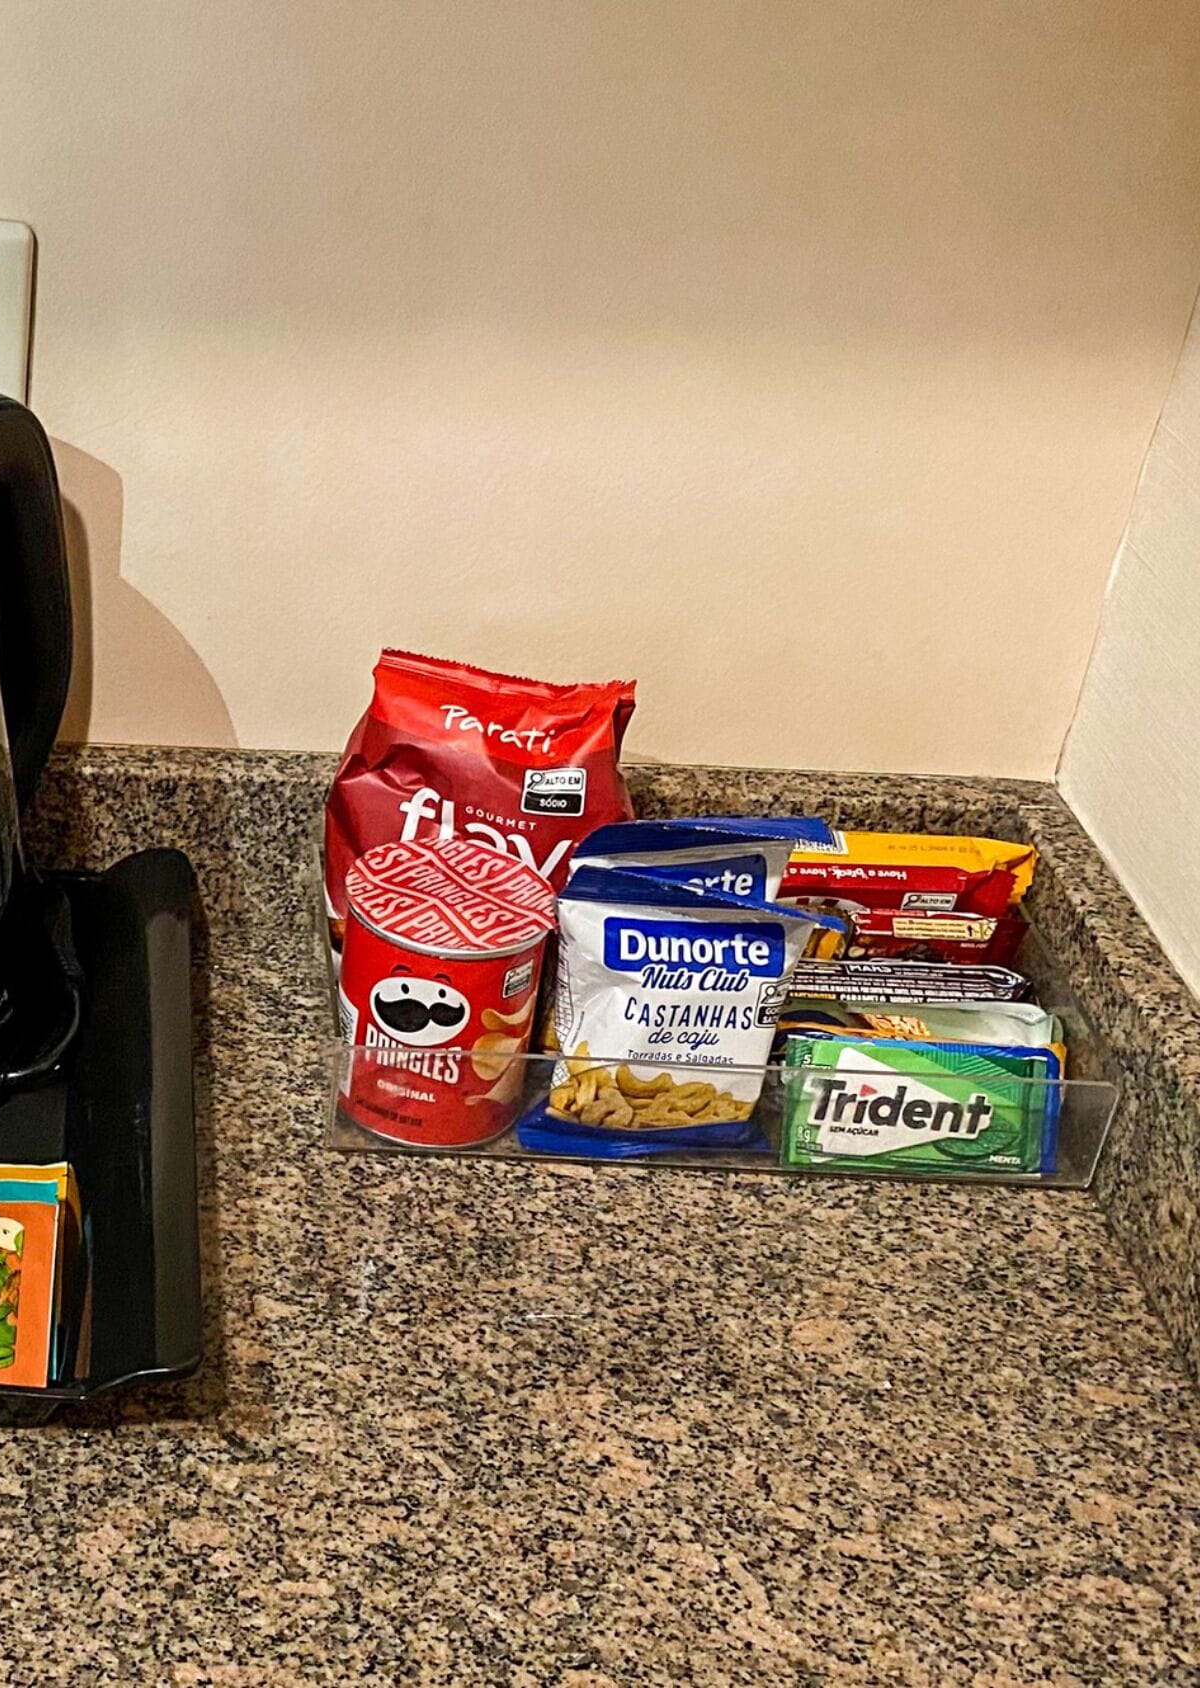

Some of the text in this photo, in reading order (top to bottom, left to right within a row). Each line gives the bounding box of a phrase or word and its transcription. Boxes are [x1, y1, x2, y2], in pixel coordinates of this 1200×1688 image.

[440, 704, 556, 754] Parati
[545, 775, 581, 786] ALTO EM
[465, 805, 537, 831] GOURMET
[392, 865, 513, 930] PRINGLES
[620, 929, 770, 967] Dunorte
[641, 966, 750, 992] Nuts Club
[624, 997, 753, 1030] CASTANHAS
[648, 1028, 720, 1050] de caju
[365, 1024, 461, 1084] PRINGLES
[628, 1049, 672, 1061] Torradas
[377, 1079, 436, 1102] ORIGINAL
[810, 1078, 992, 1134] Trident
[846, 1126, 879, 1137] AÇÚCAR
[988, 1154, 1021, 1165] MENTA
